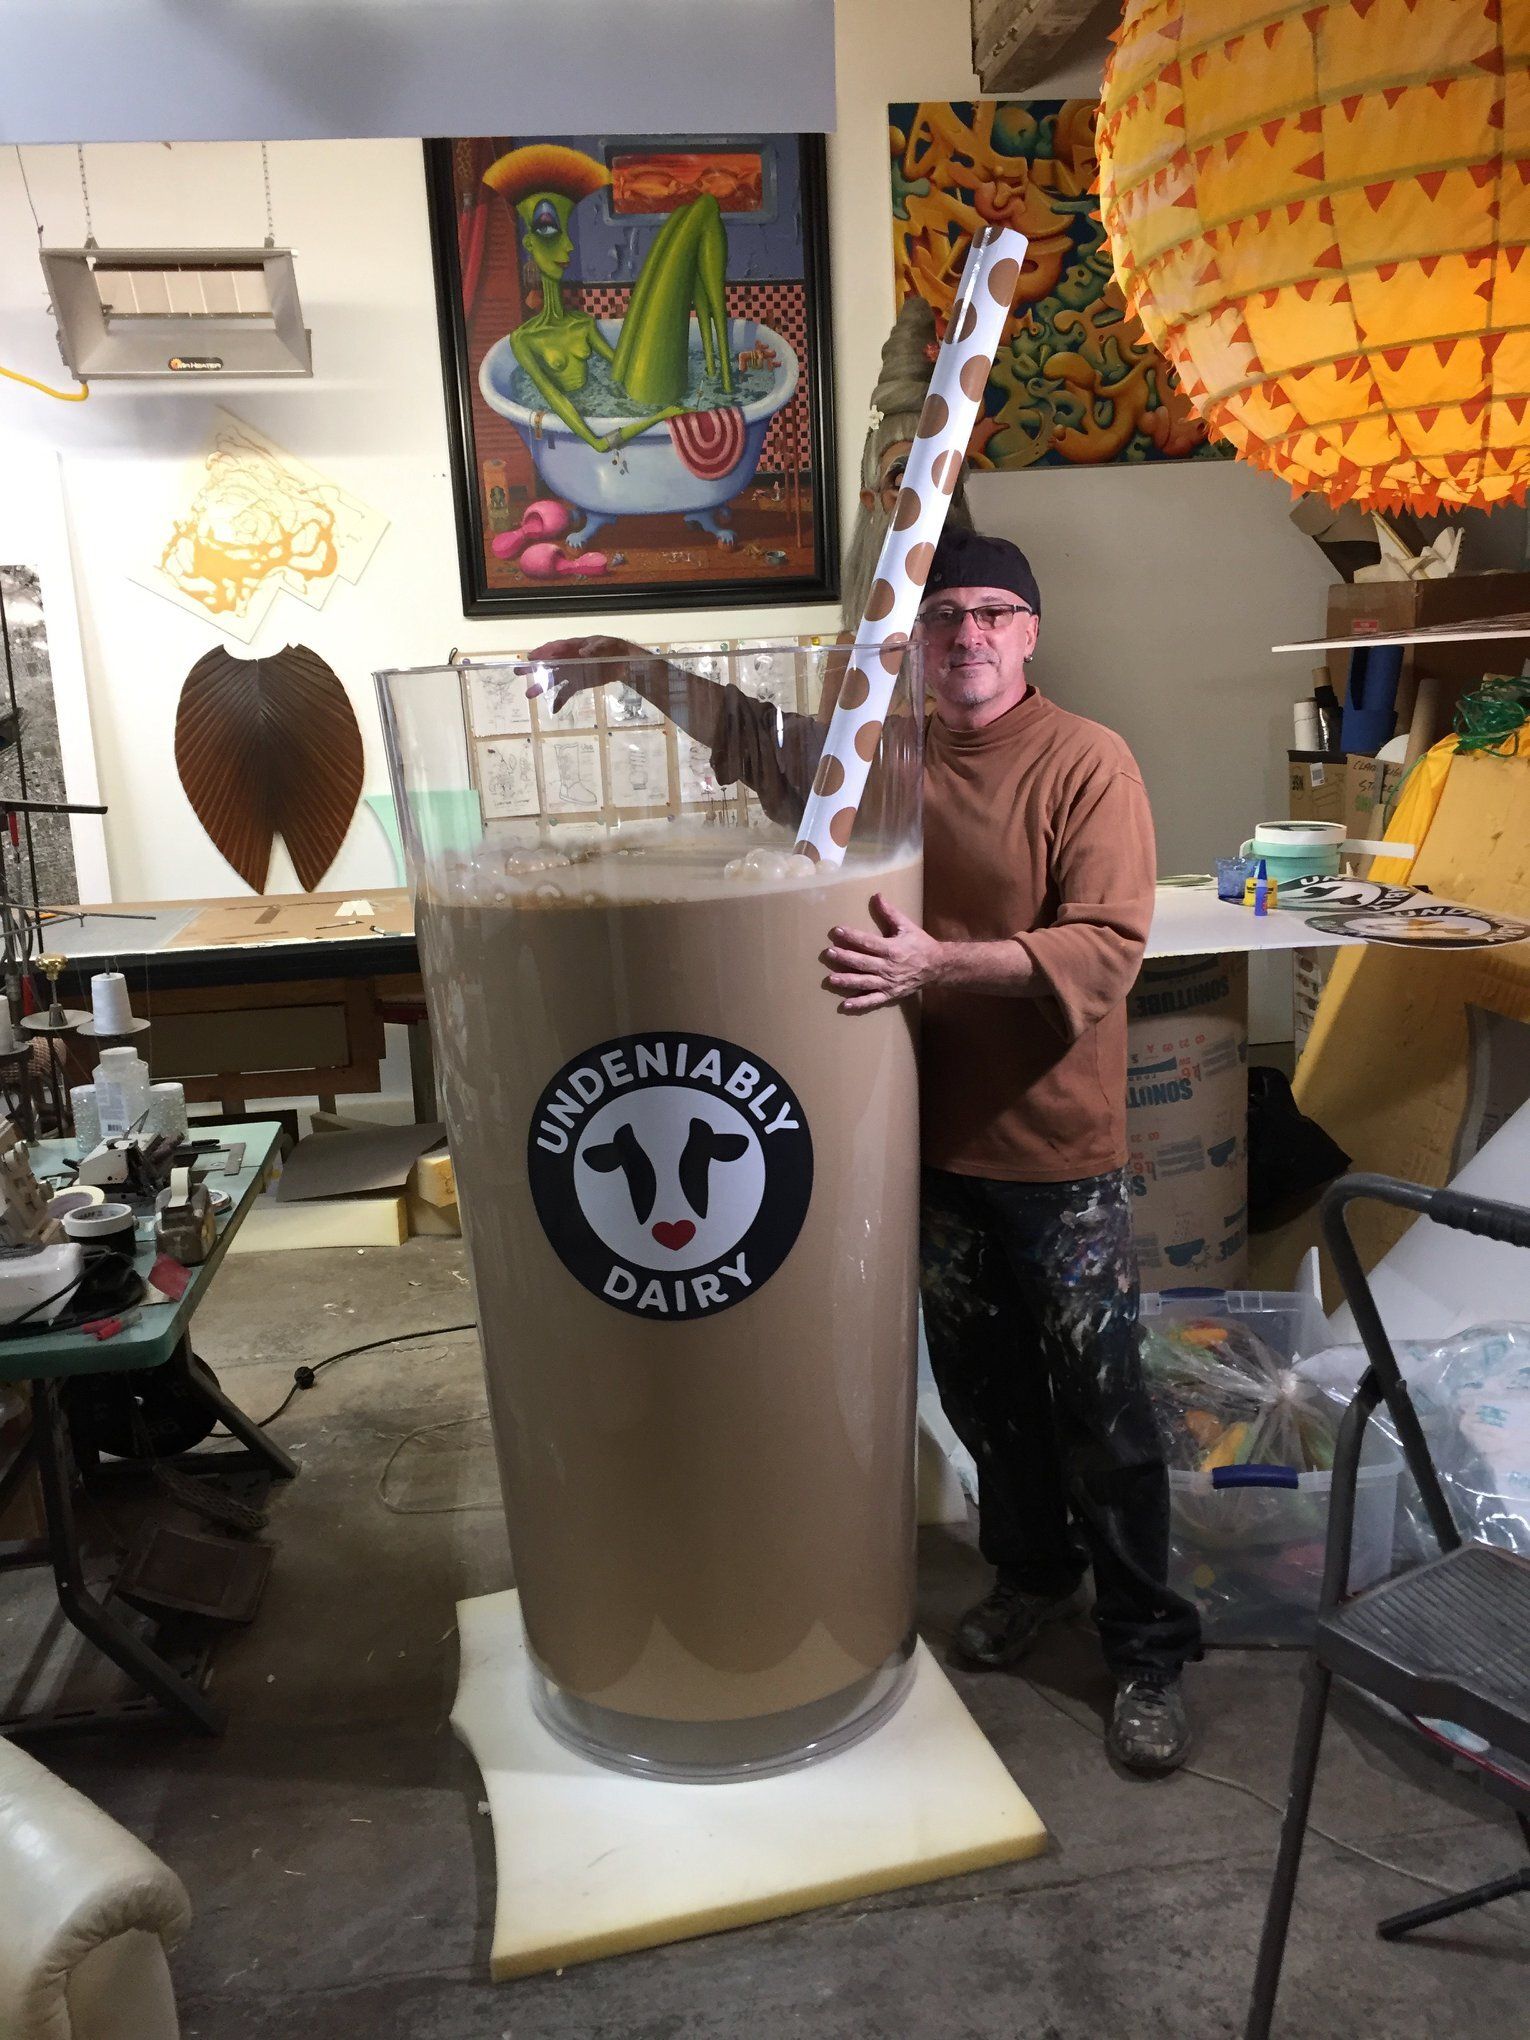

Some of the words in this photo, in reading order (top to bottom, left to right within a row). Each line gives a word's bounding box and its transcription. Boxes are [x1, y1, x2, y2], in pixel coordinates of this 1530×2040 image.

[536, 1041, 800, 1155] UNDENIABLY
[1126, 1077, 1194, 1109] SONOT
[602, 1251, 752, 1313] DAIRY
